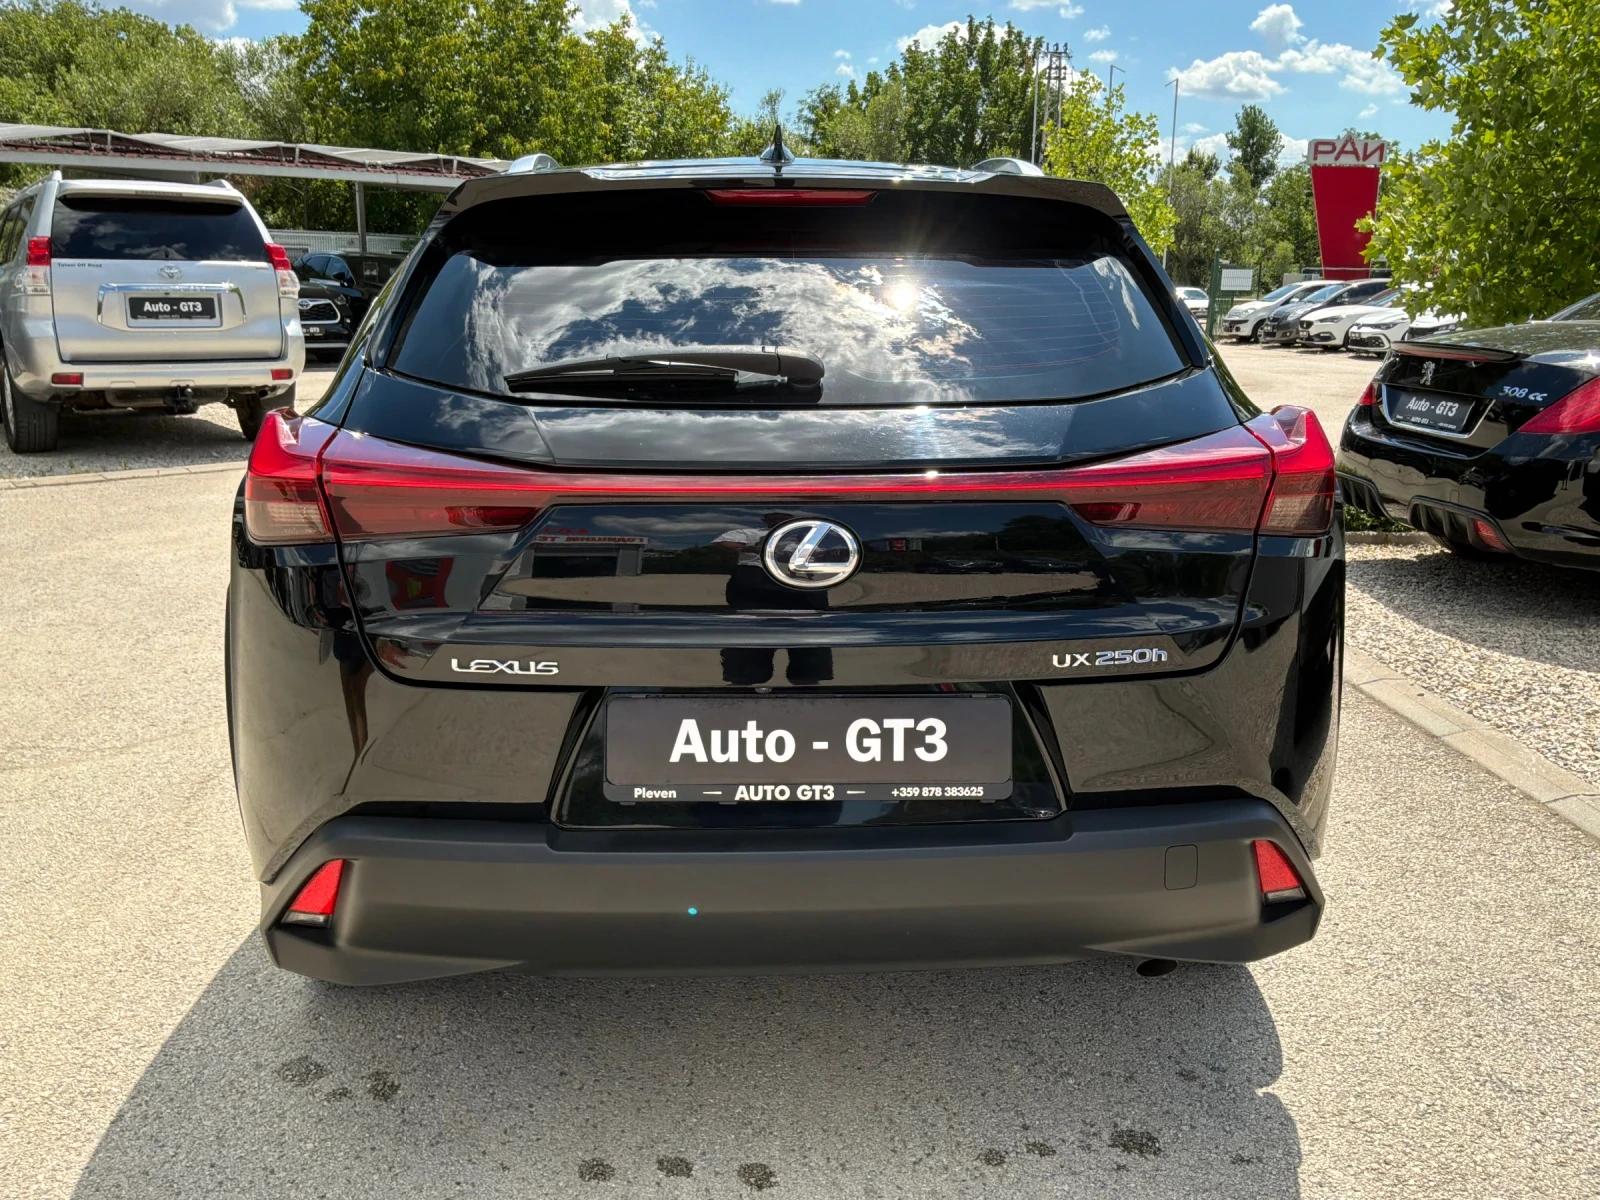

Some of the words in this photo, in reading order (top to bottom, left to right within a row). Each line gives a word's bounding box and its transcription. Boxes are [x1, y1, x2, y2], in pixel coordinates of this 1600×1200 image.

[143, 301, 171, 312] Auto
[179, 301, 203, 312] GT3
[1498, 385, 1528, 398] 308
[1406, 396, 1430, 412] Auto
[1435, 400, 1460, 417] GT3
[1052, 652, 1092, 668] UX
[1095, 647, 1168, 666] 250h
[451, 658, 559, 676] LEXUS
[669, 718, 796, 763] Auto
[845, 717, 948, 763] GT3
[633, 786, 677, 799] Pleven
[734, 785, 791, 801] AUTO
[796, 785, 835, 801] GT3
[891, 786, 920, 798] +359
[921, 786, 942, 798] 878
[944, 786, 984, 798] 383625
